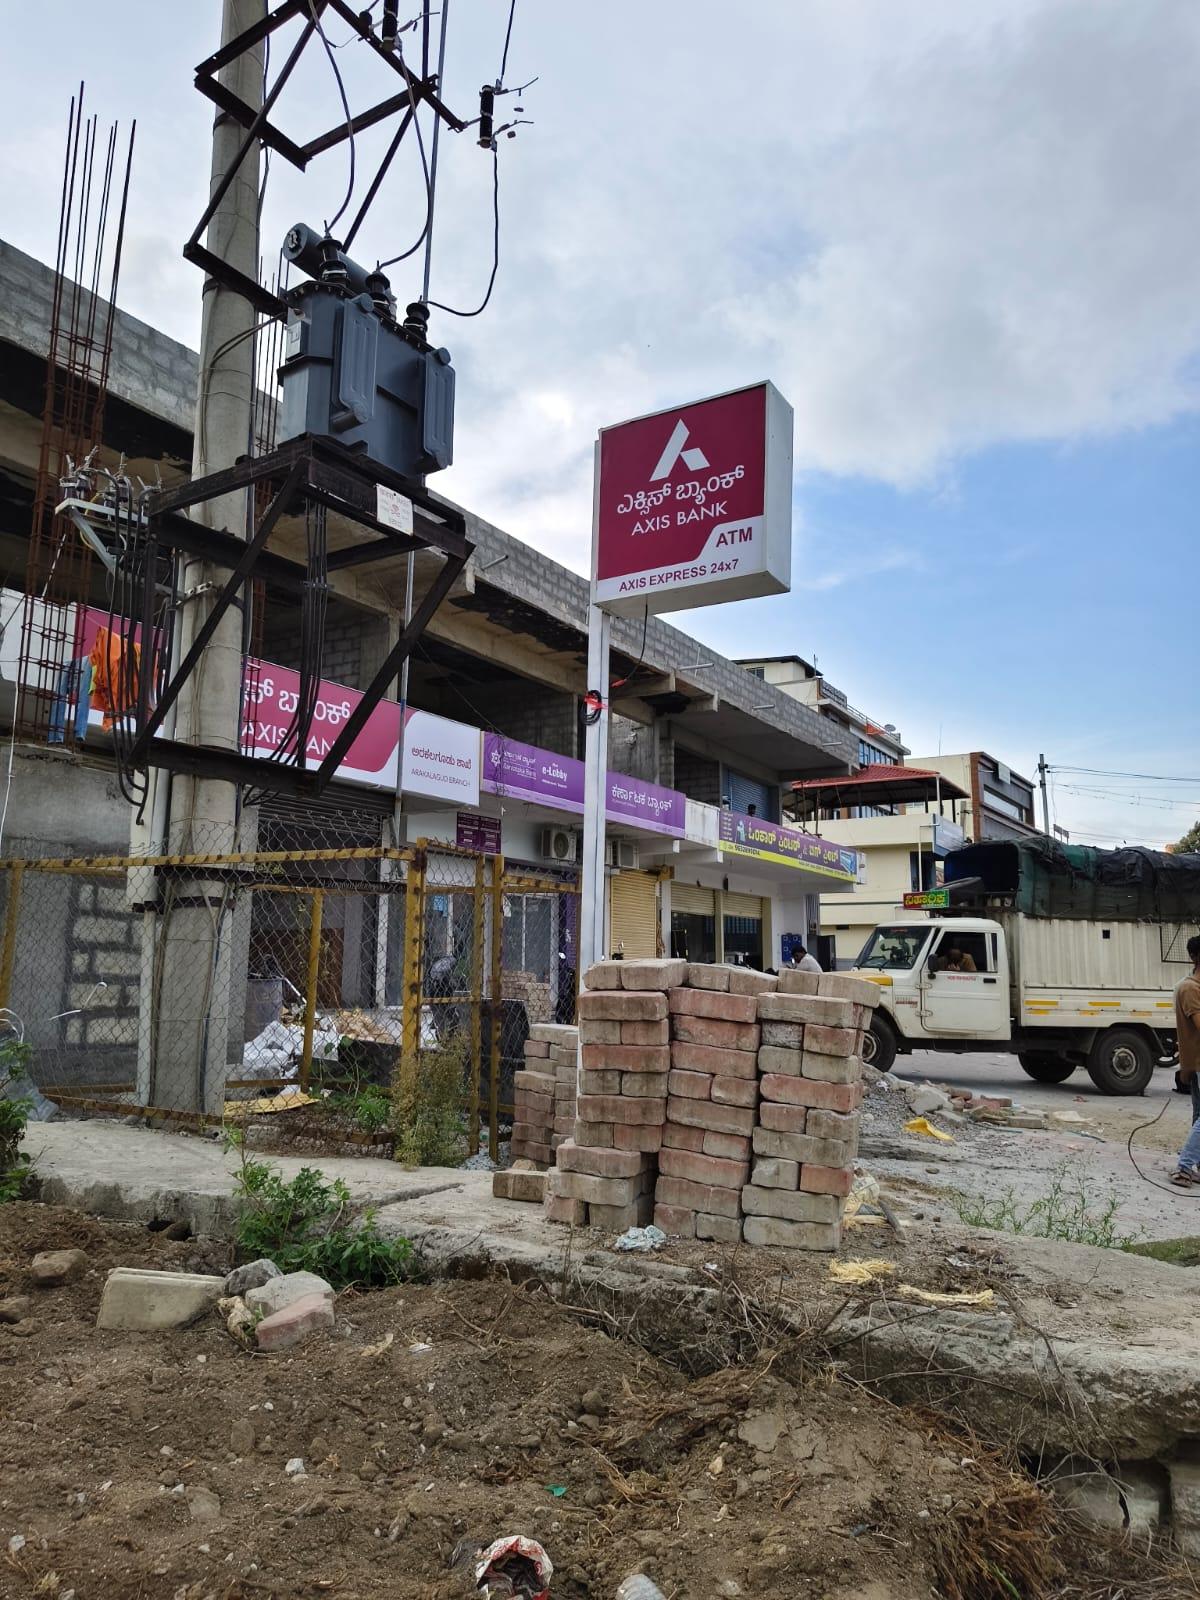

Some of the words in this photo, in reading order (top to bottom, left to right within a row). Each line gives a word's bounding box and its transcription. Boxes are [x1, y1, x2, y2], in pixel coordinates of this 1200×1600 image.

[675, 464, 745, 505] ಬ್ಯಾಂಕ್
[631, 514, 671, 536] AXIS
[676, 500, 728, 526] BANK
[715, 526, 753, 548] ATM
[619, 576, 647, 592] AXIS
[649, 564, 707, 587] EXPRESS
[710, 558, 739, 574] 24x7
